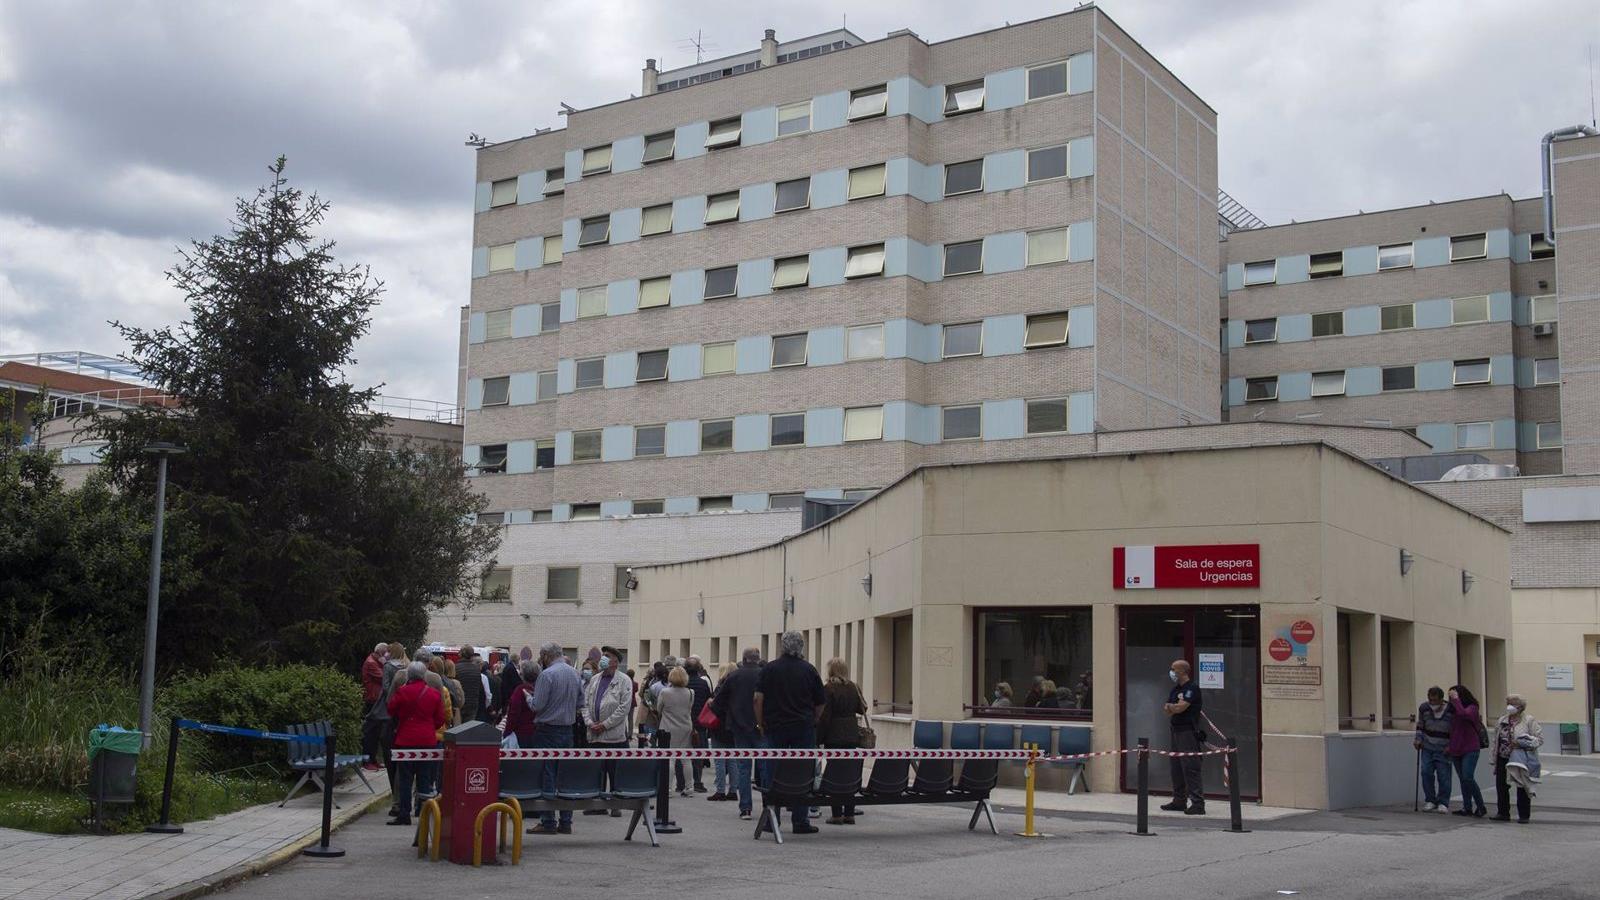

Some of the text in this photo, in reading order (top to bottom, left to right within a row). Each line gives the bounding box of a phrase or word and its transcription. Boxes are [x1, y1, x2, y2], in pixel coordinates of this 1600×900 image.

[1175, 559, 1253, 570] Sala de espera
[1200, 571, 1253, 584] Urgencias
